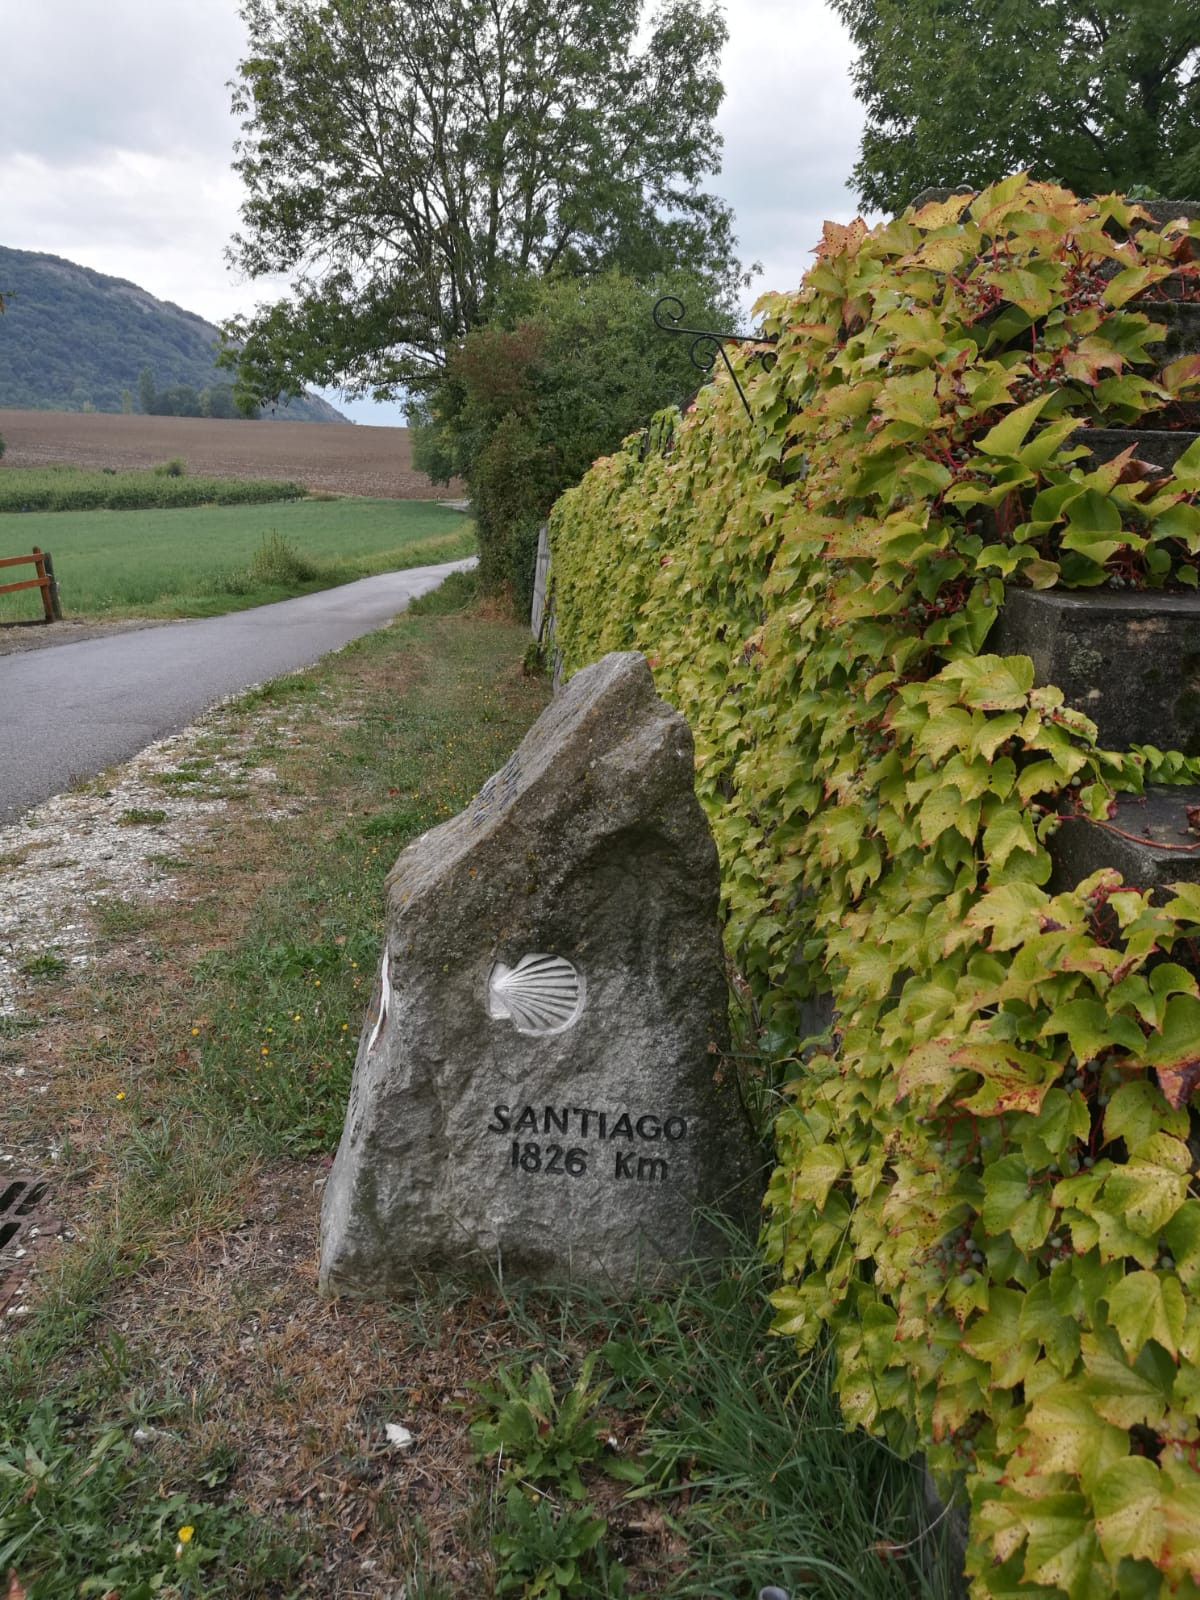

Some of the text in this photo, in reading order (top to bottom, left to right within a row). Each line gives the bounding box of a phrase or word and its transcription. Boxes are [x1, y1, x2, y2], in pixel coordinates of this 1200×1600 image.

[487, 1104, 688, 1142] SANTIAGO
[511, 1142, 668, 1181] 1826 Km
